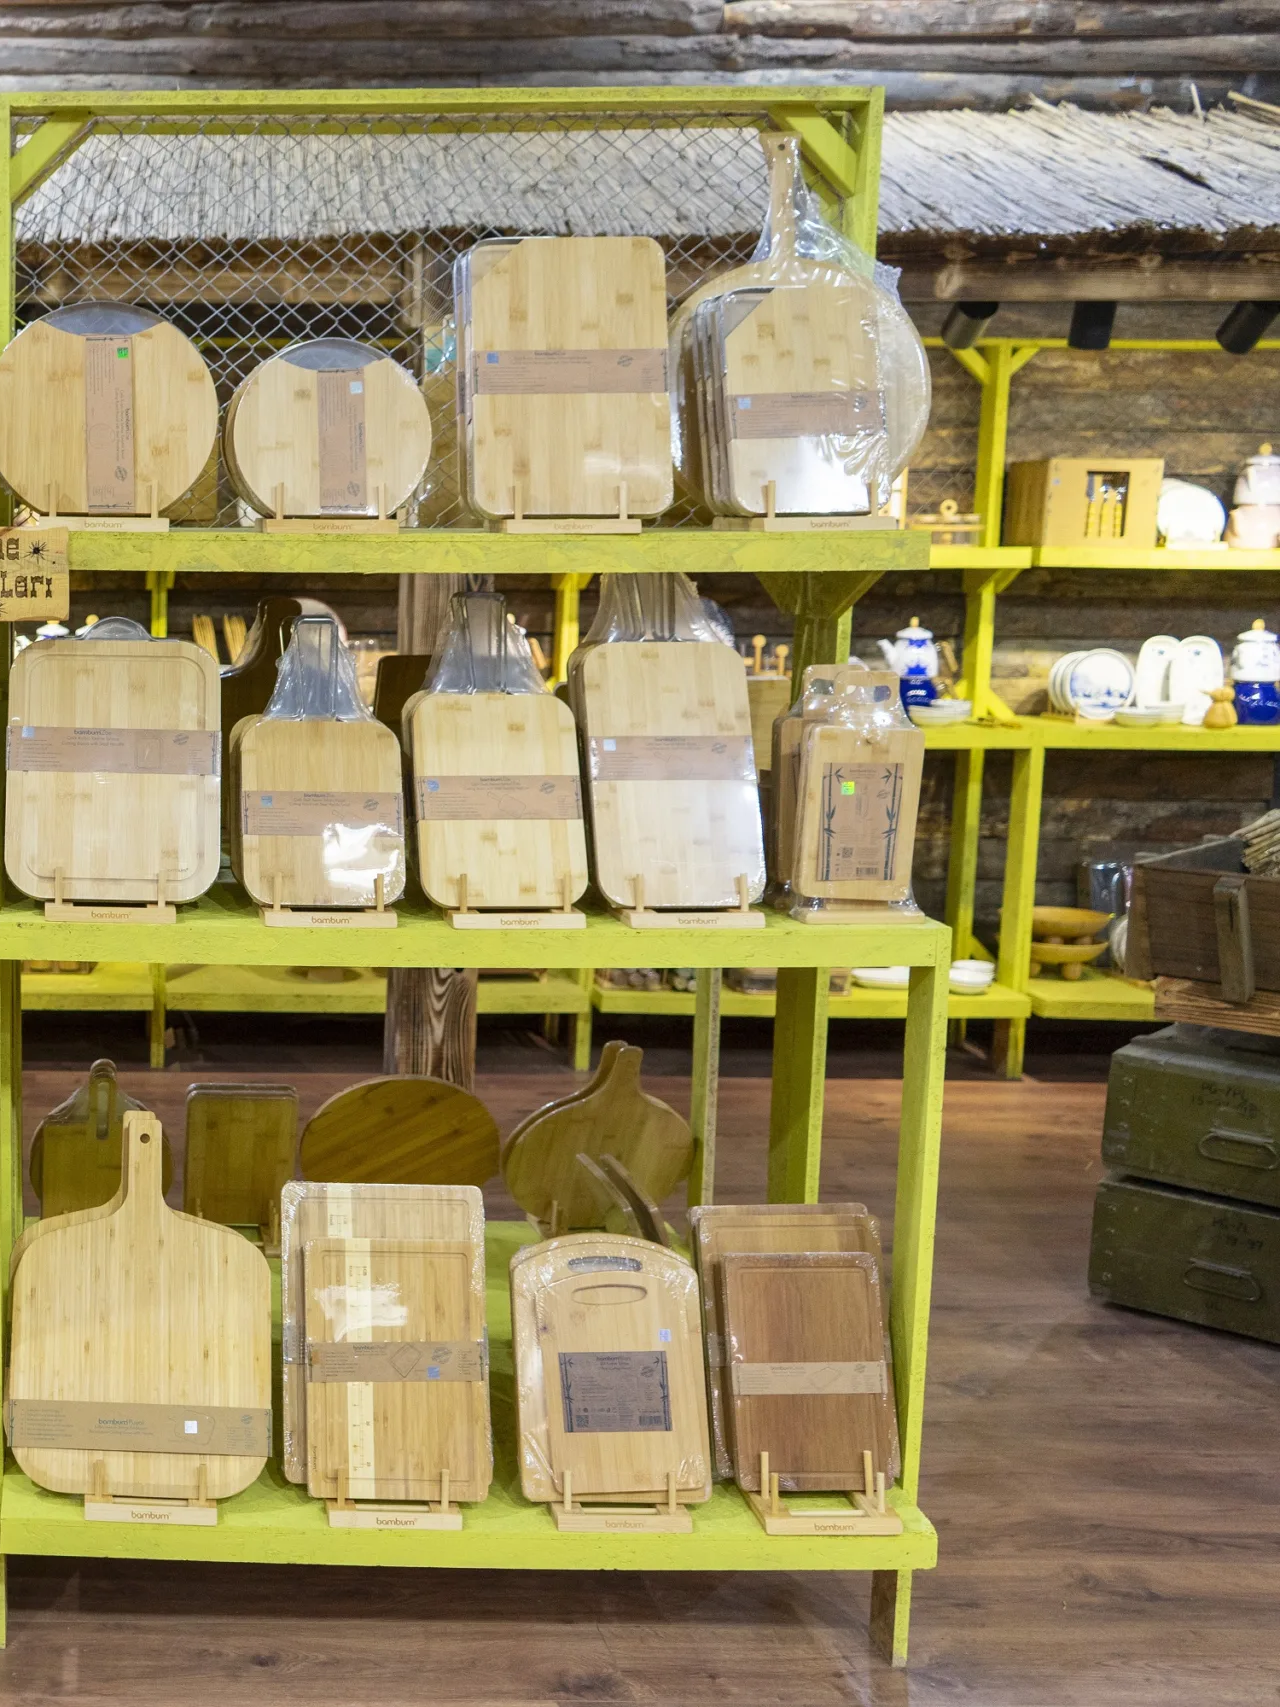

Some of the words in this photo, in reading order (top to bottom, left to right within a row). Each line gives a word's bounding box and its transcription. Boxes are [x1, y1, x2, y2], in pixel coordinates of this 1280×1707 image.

[84, 520, 122, 528] bambum
[810, 519, 849, 528] bambum
[91, 911, 129, 919] bambum
[311, 916, 350, 924] bambum
[500, 916, 539, 925] bambum
[678, 916, 717, 924] bambum
[131, 1510, 169, 1520] bambum
[377, 1518, 415, 1526] bambum
[605, 1520, 644, 1528] bambum
[814, 1523, 854, 1531] bambum
